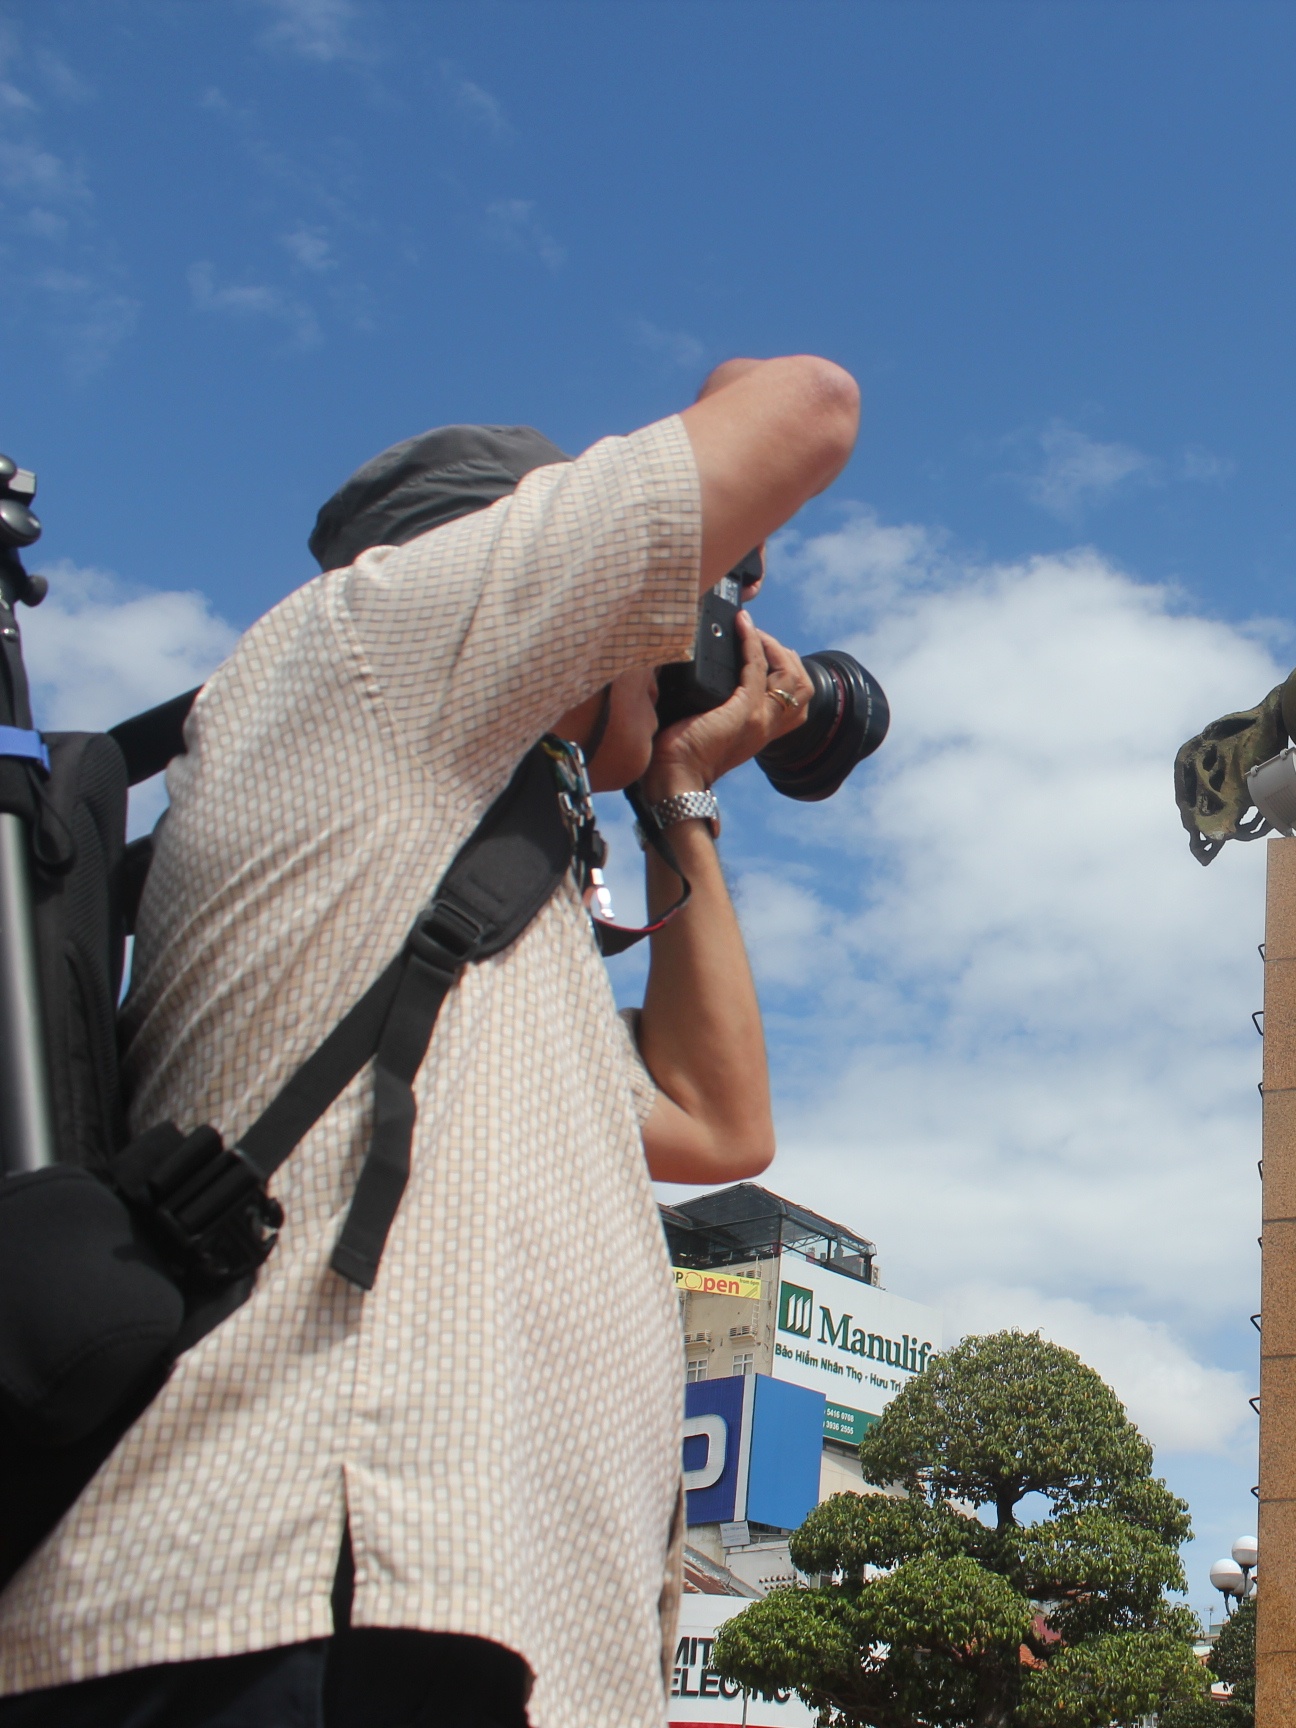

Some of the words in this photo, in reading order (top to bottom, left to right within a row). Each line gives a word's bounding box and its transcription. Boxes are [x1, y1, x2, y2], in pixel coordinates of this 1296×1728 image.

[684, 1271, 740, 1295] Open
[775, 1343, 793, 1360] Bảo
[795, 1348, 819, 1368] Hiểm
[820, 1357, 844, 1376] Nhân
[846, 1365, 863, 1384] Thọ
